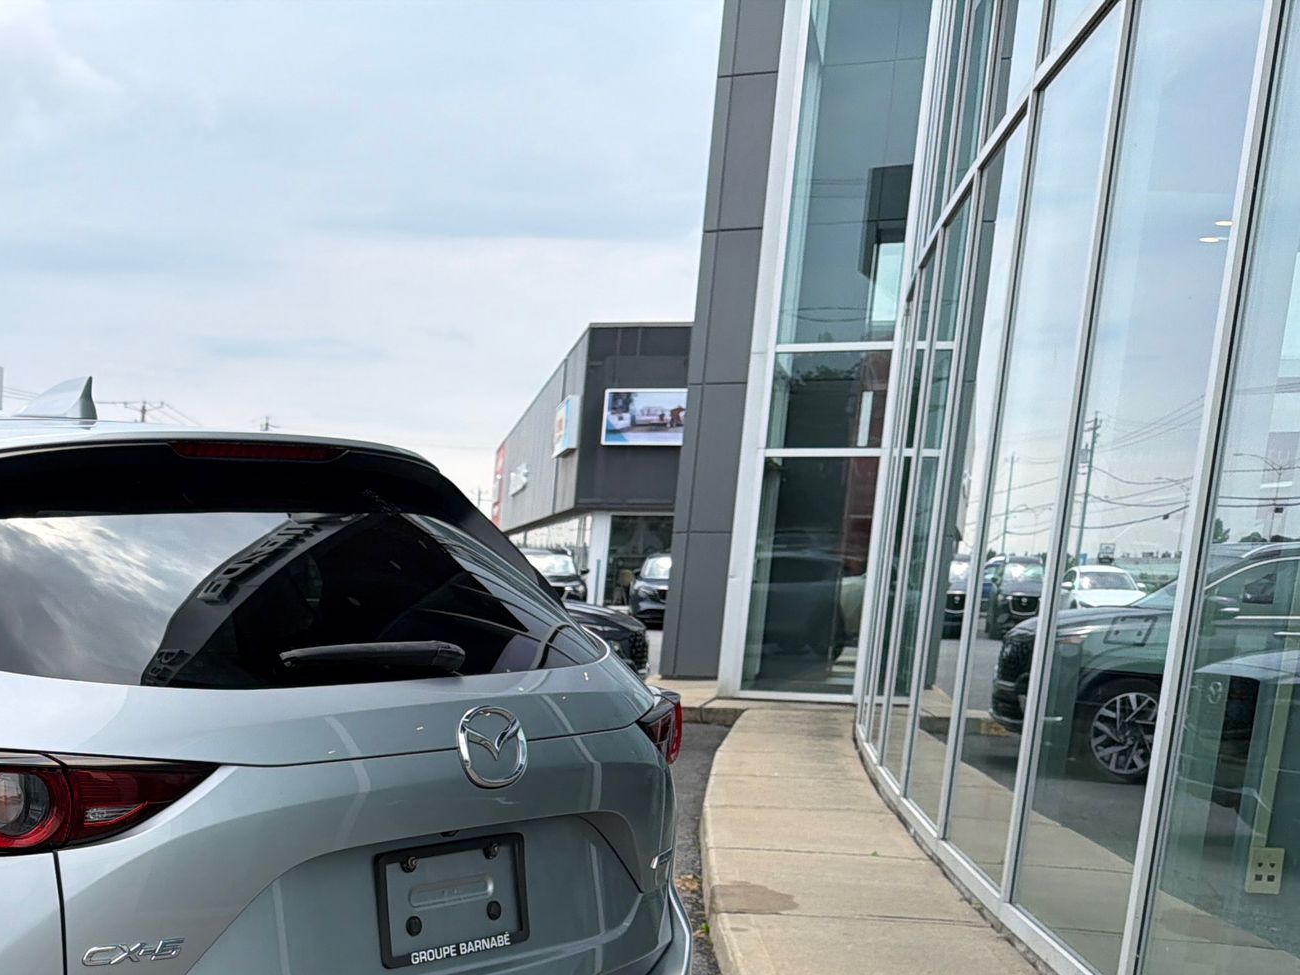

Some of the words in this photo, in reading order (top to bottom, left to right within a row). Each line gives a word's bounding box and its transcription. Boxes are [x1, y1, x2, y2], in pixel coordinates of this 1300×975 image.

[82, 938, 186, 967] CX-5
[411, 943, 457, 965] GROUPE
[460, 932, 511, 955] BARNABÉ
